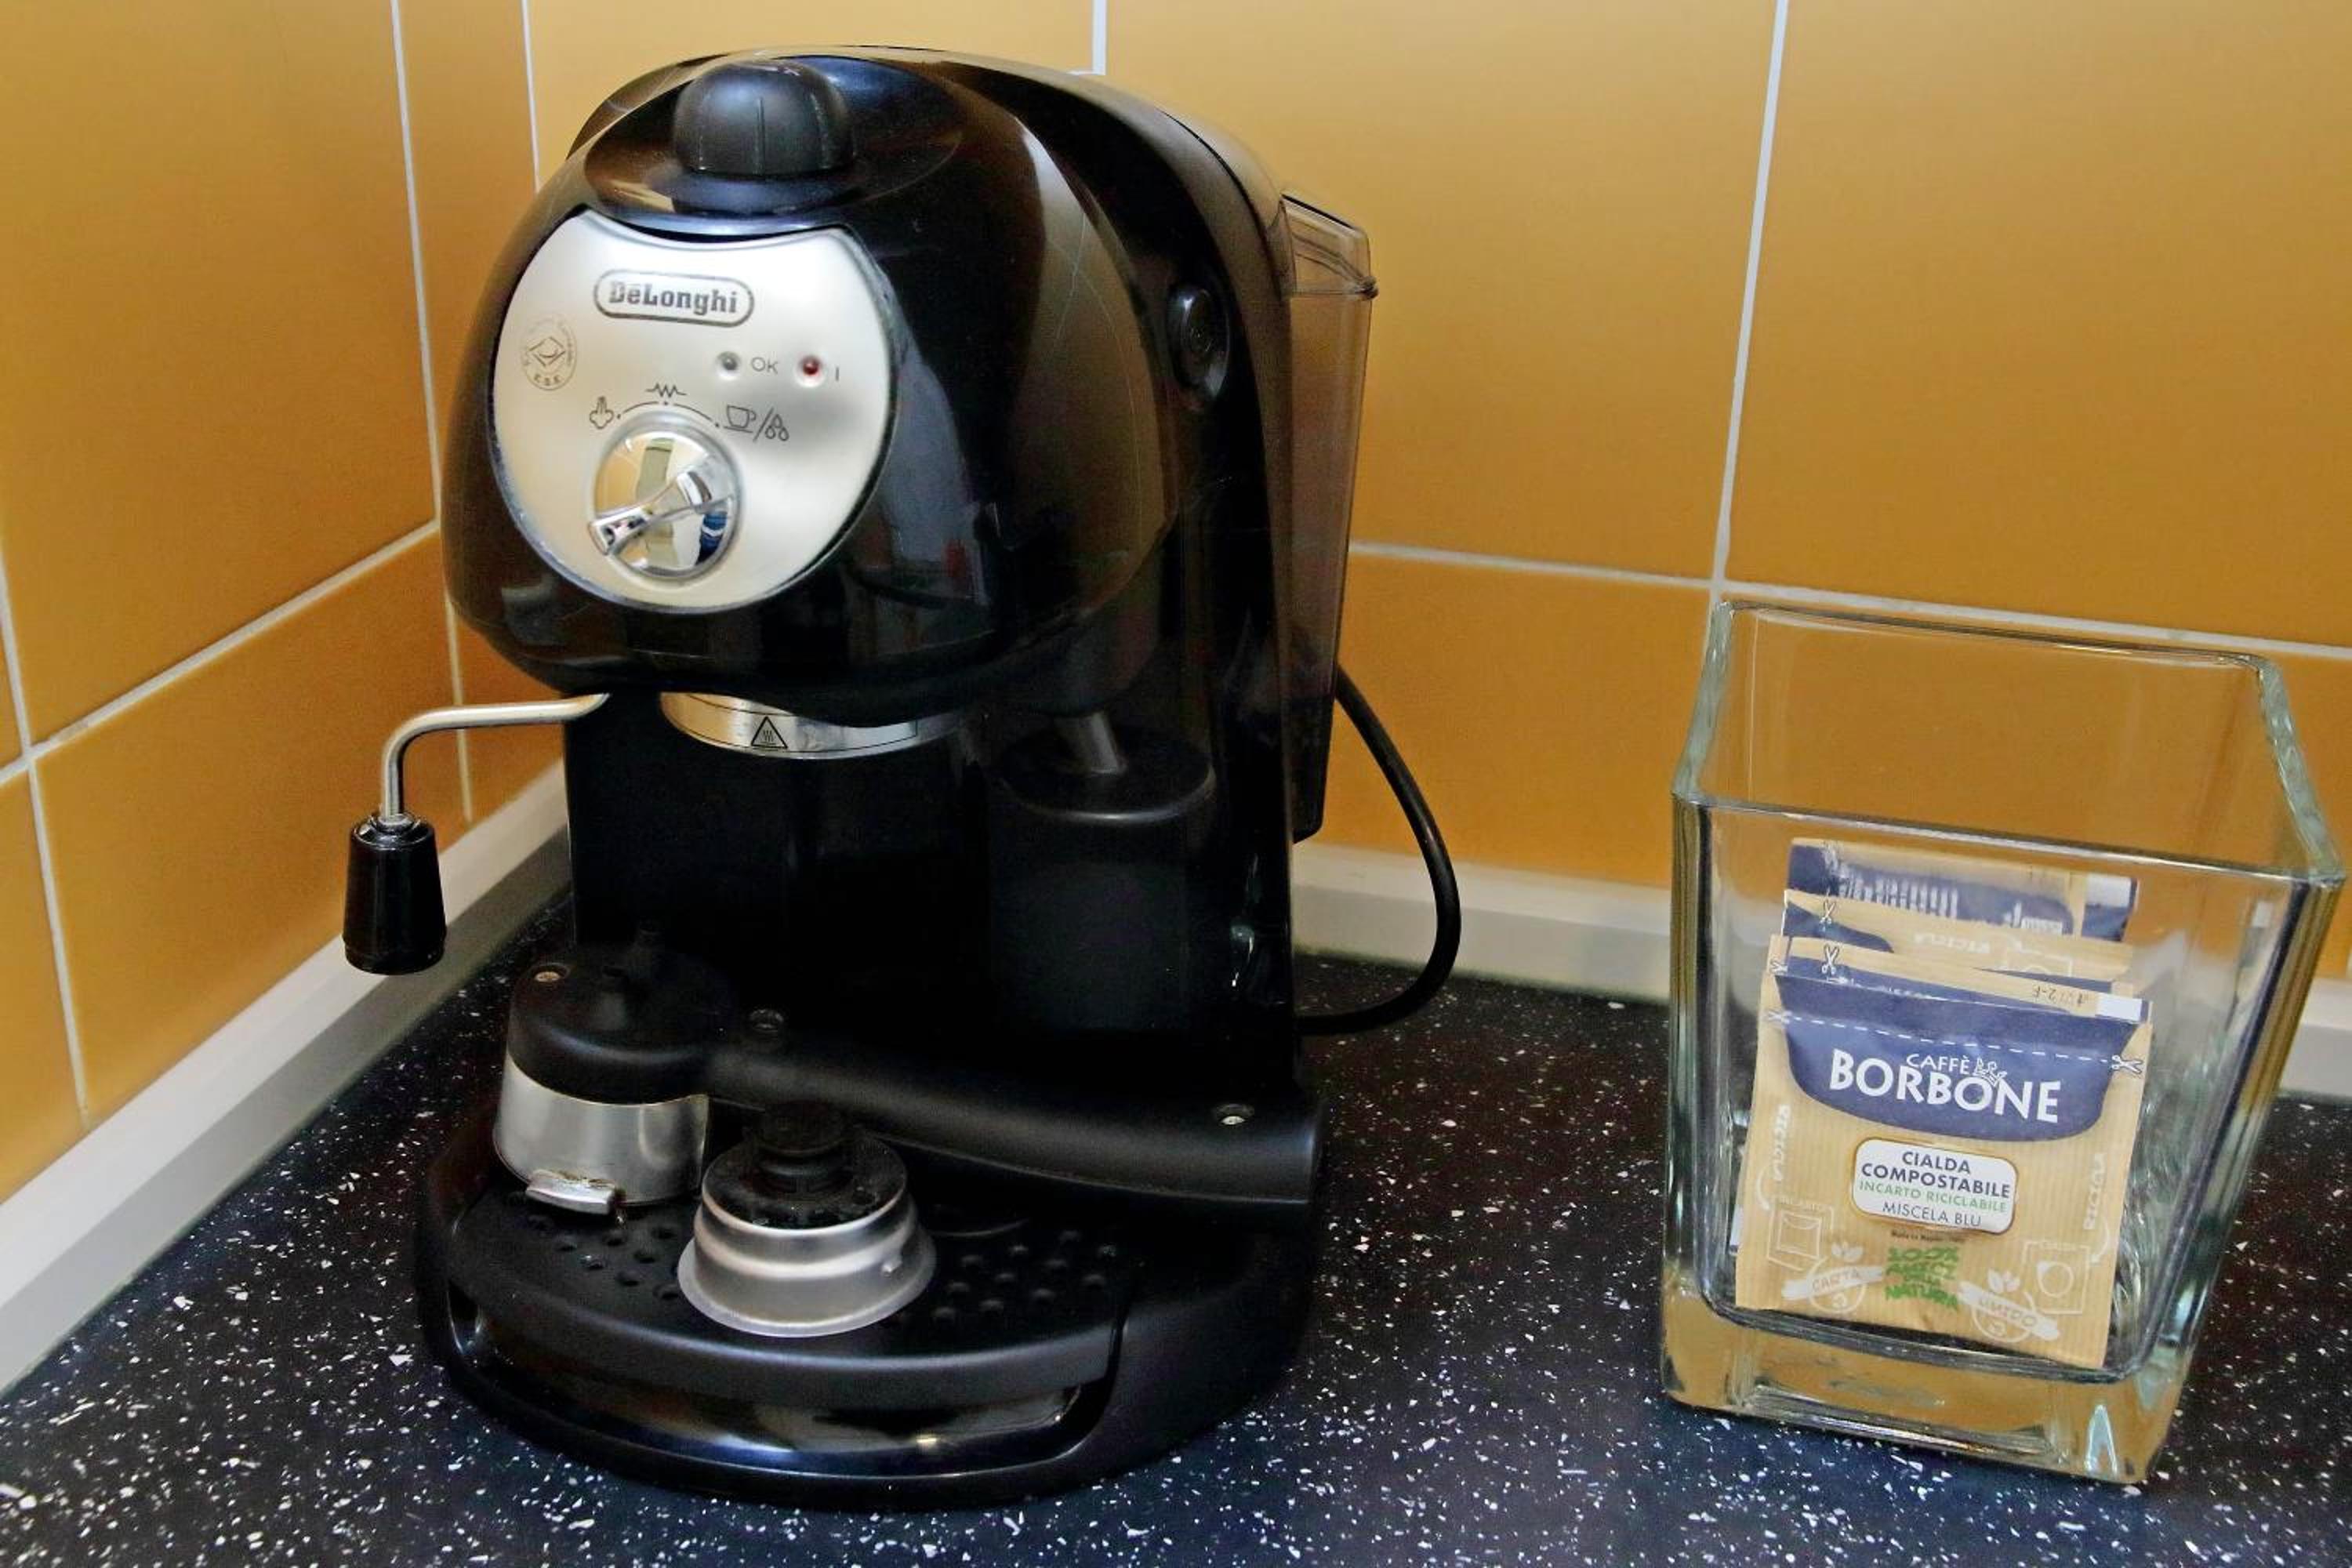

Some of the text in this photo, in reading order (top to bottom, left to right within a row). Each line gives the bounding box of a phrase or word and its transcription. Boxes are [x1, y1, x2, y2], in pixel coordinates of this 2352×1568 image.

[750, 356, 779, 375] OK
[1906, 1053, 1971, 1076] CAFFÈ
[1829, 1047, 2061, 1123] BORBONE
[1902, 1151, 1971, 1174] CIALDA
[1861, 1163, 2011, 1199] COMPOSTABILE
[1859, 1180, 2008, 1213] INCARTO RICICLABILE
[1882, 1201, 1982, 1227] MISCELA BLU
